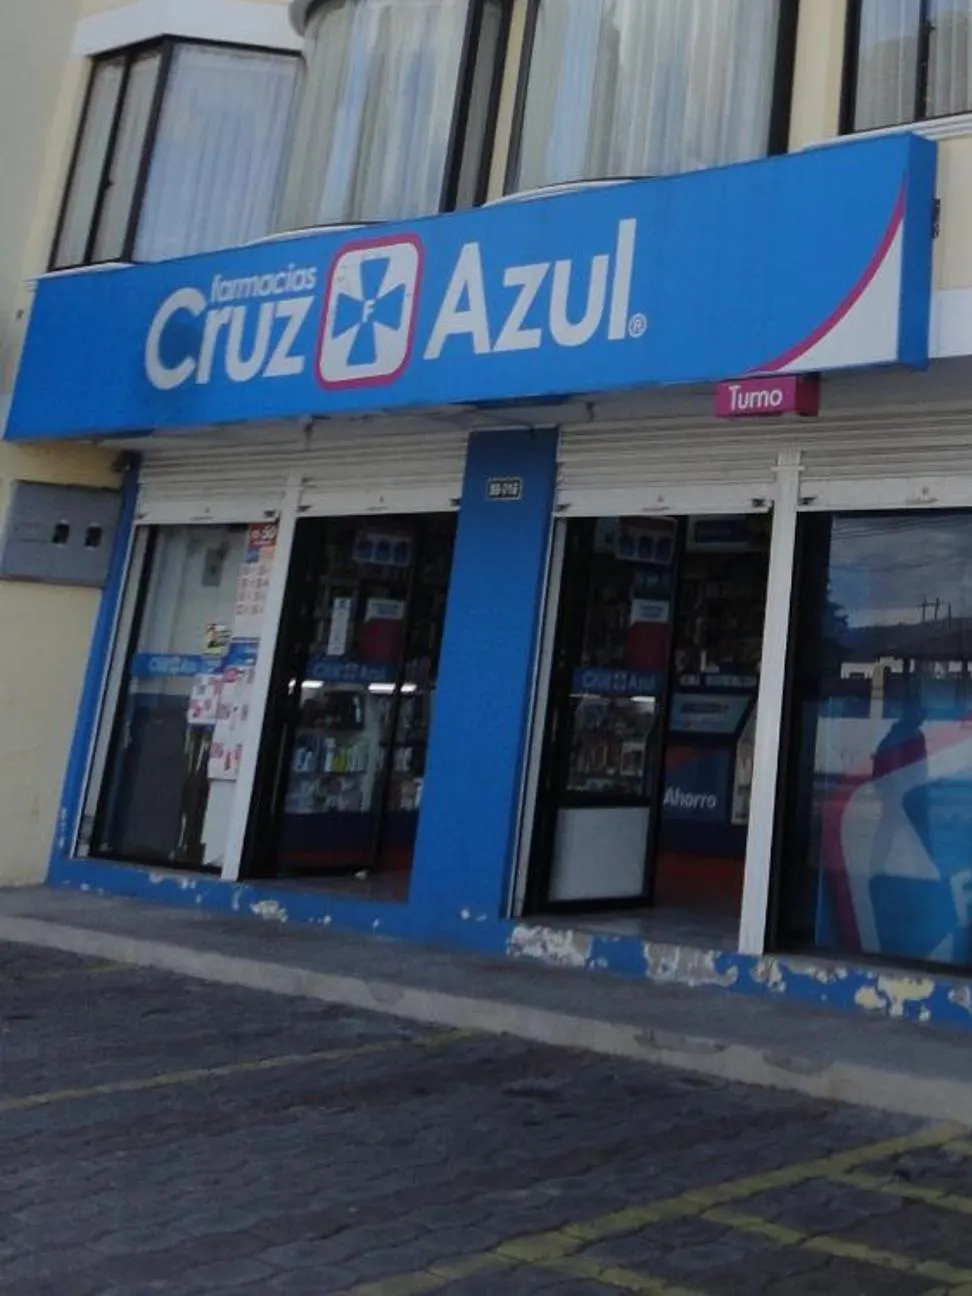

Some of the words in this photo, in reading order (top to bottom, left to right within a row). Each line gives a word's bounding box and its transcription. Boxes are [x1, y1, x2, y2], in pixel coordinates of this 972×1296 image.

[210, 262, 317, 303] farmacias
[145, 287, 316, 390] Cruz
[423, 218, 637, 360] Azul
[728, 384, 783, 411] Turno
[663, 787, 718, 811] Ahorro
